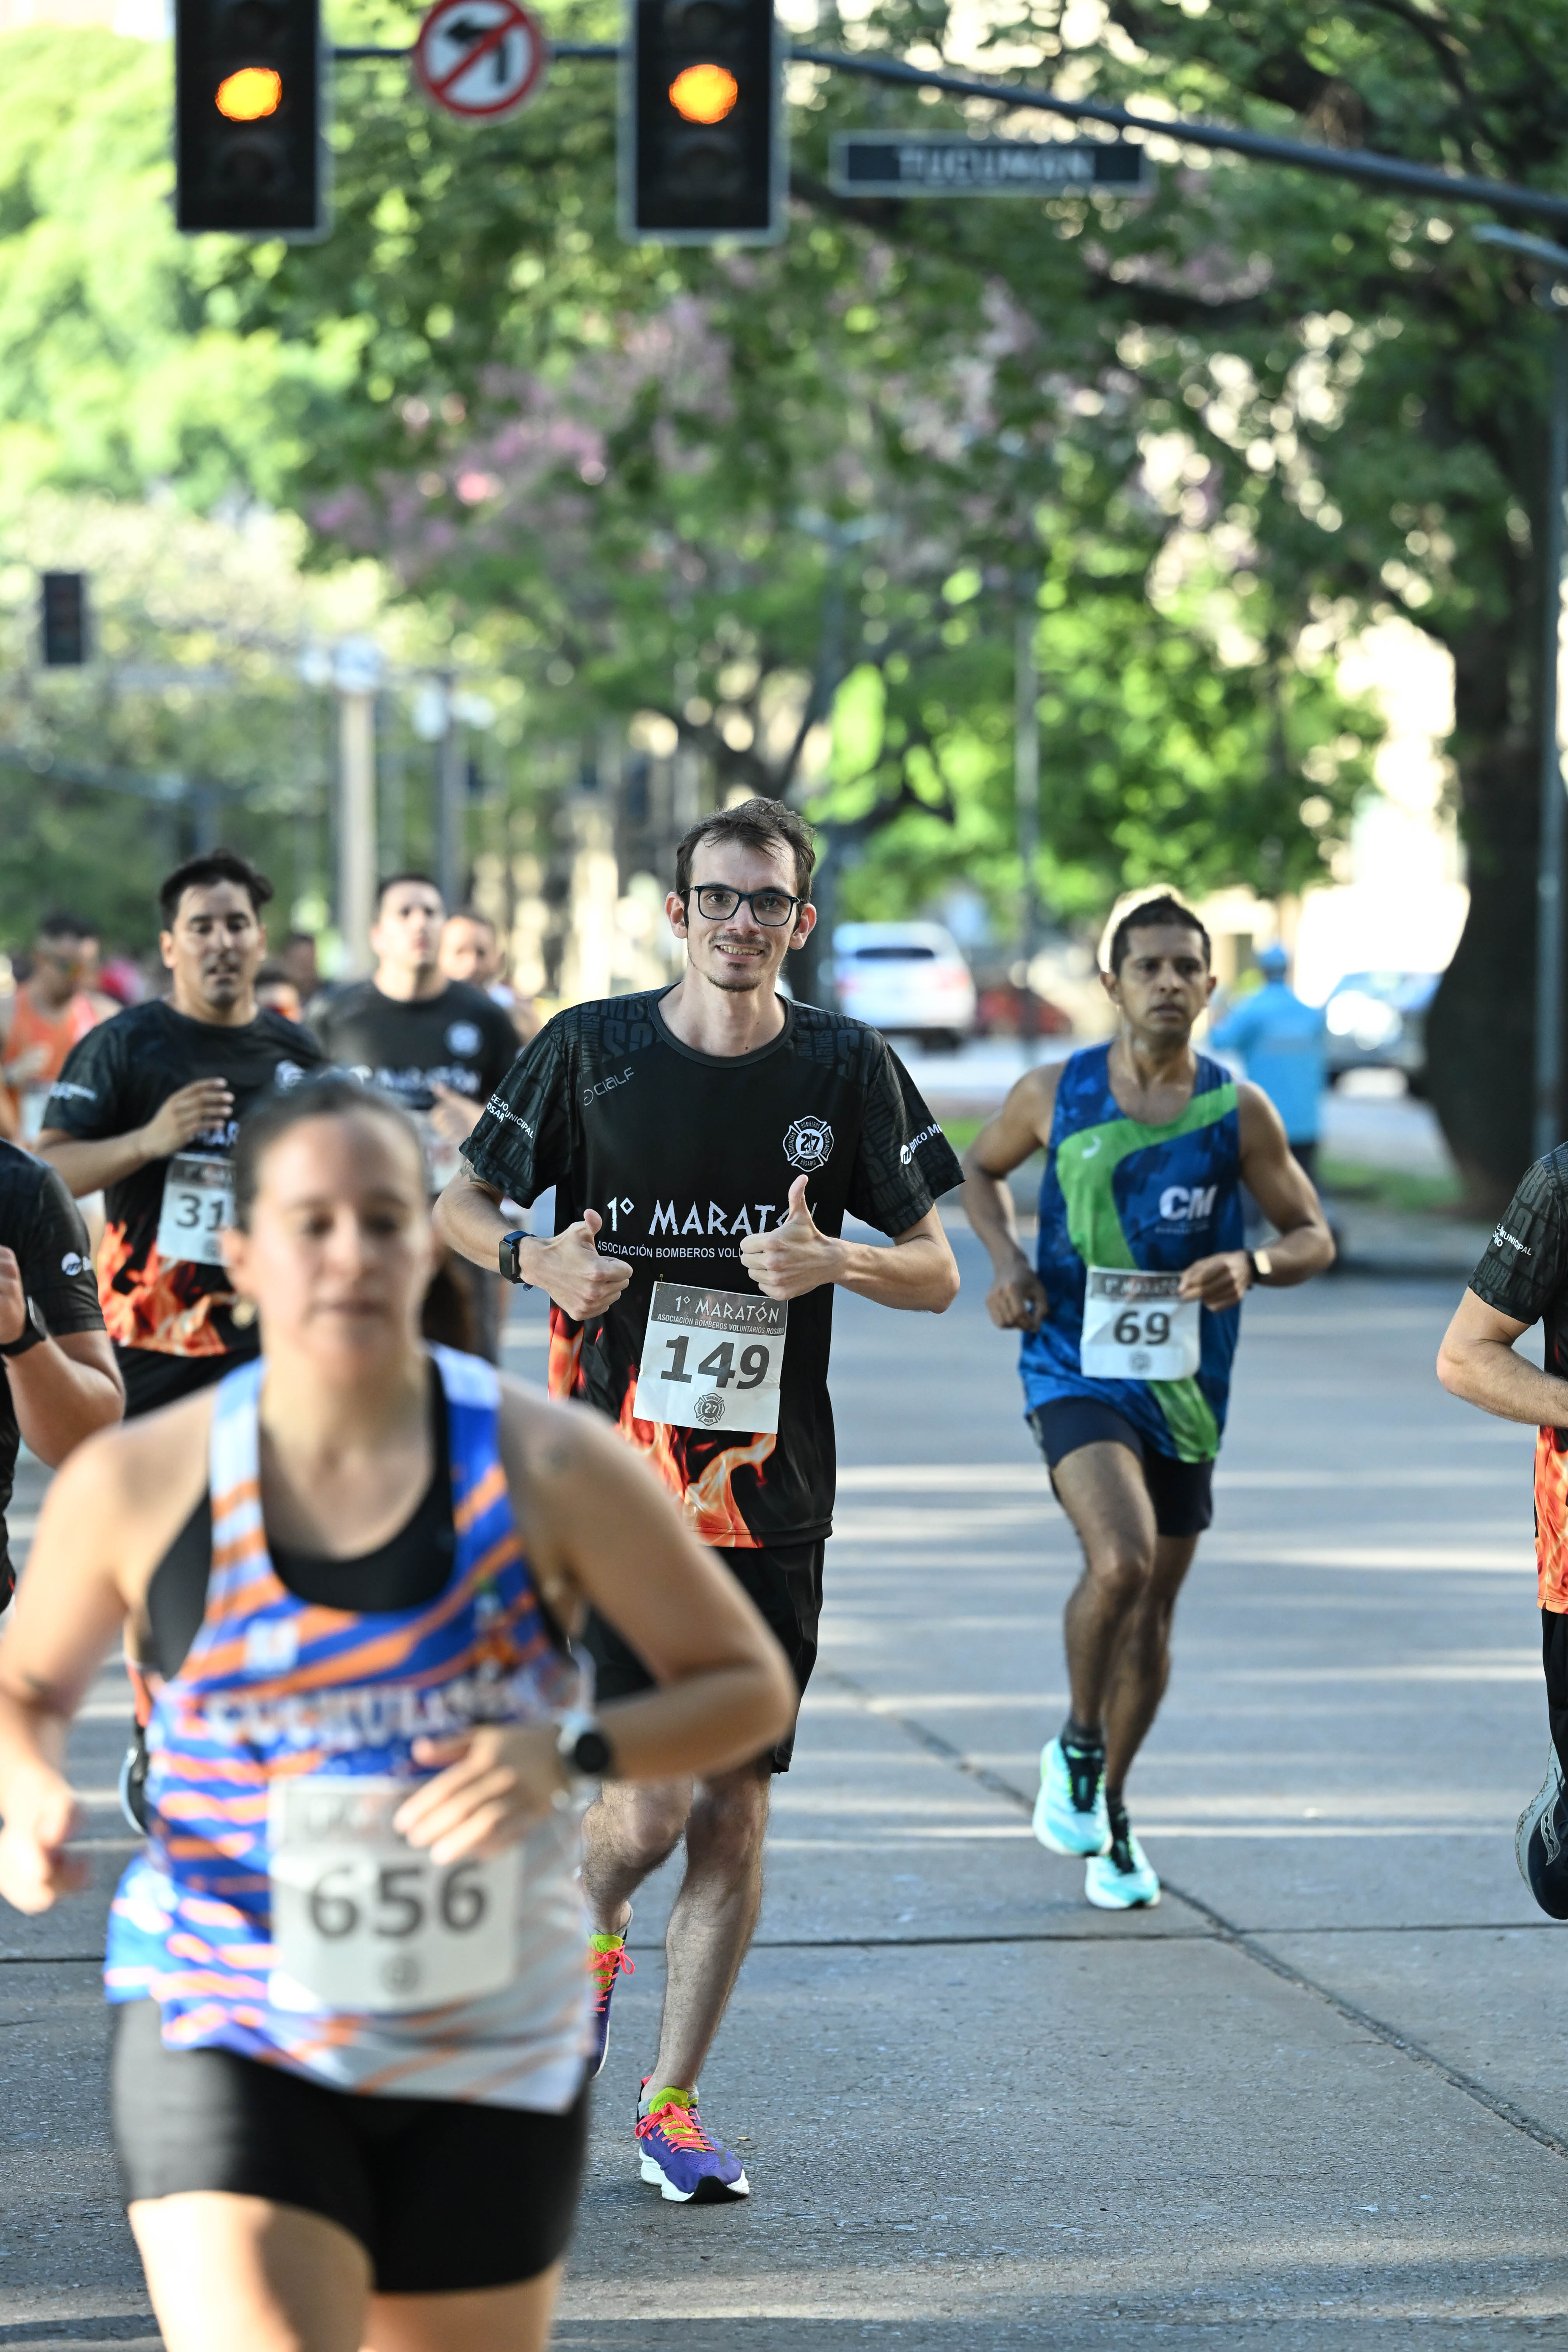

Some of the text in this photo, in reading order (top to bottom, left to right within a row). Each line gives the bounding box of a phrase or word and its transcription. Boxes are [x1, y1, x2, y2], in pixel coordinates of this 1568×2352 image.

[800, 1121, 820, 1129] BOMBEROS
[800, 1133, 820, 1151] 27
[1158, 1184, 1218, 1220] CM
[597, 1240, 653, 1258] ASOCIACIÓN
[656, 1247, 715, 1258] BOMBEROS
[695, 1298, 779, 1324] MARATÓN
[657, 1313, 693, 1325] ASOCIACIÓN
[695, 1319, 727, 1330] BOMBEROS
[729, 1323, 765, 1334] VOLUNTARIOS
[1113, 1311, 1170, 1346] 69
[660, 1335, 770, 1390] 149
[704, 1403, 717, 1413] 27
[308, 1862, 488, 1939] 656
